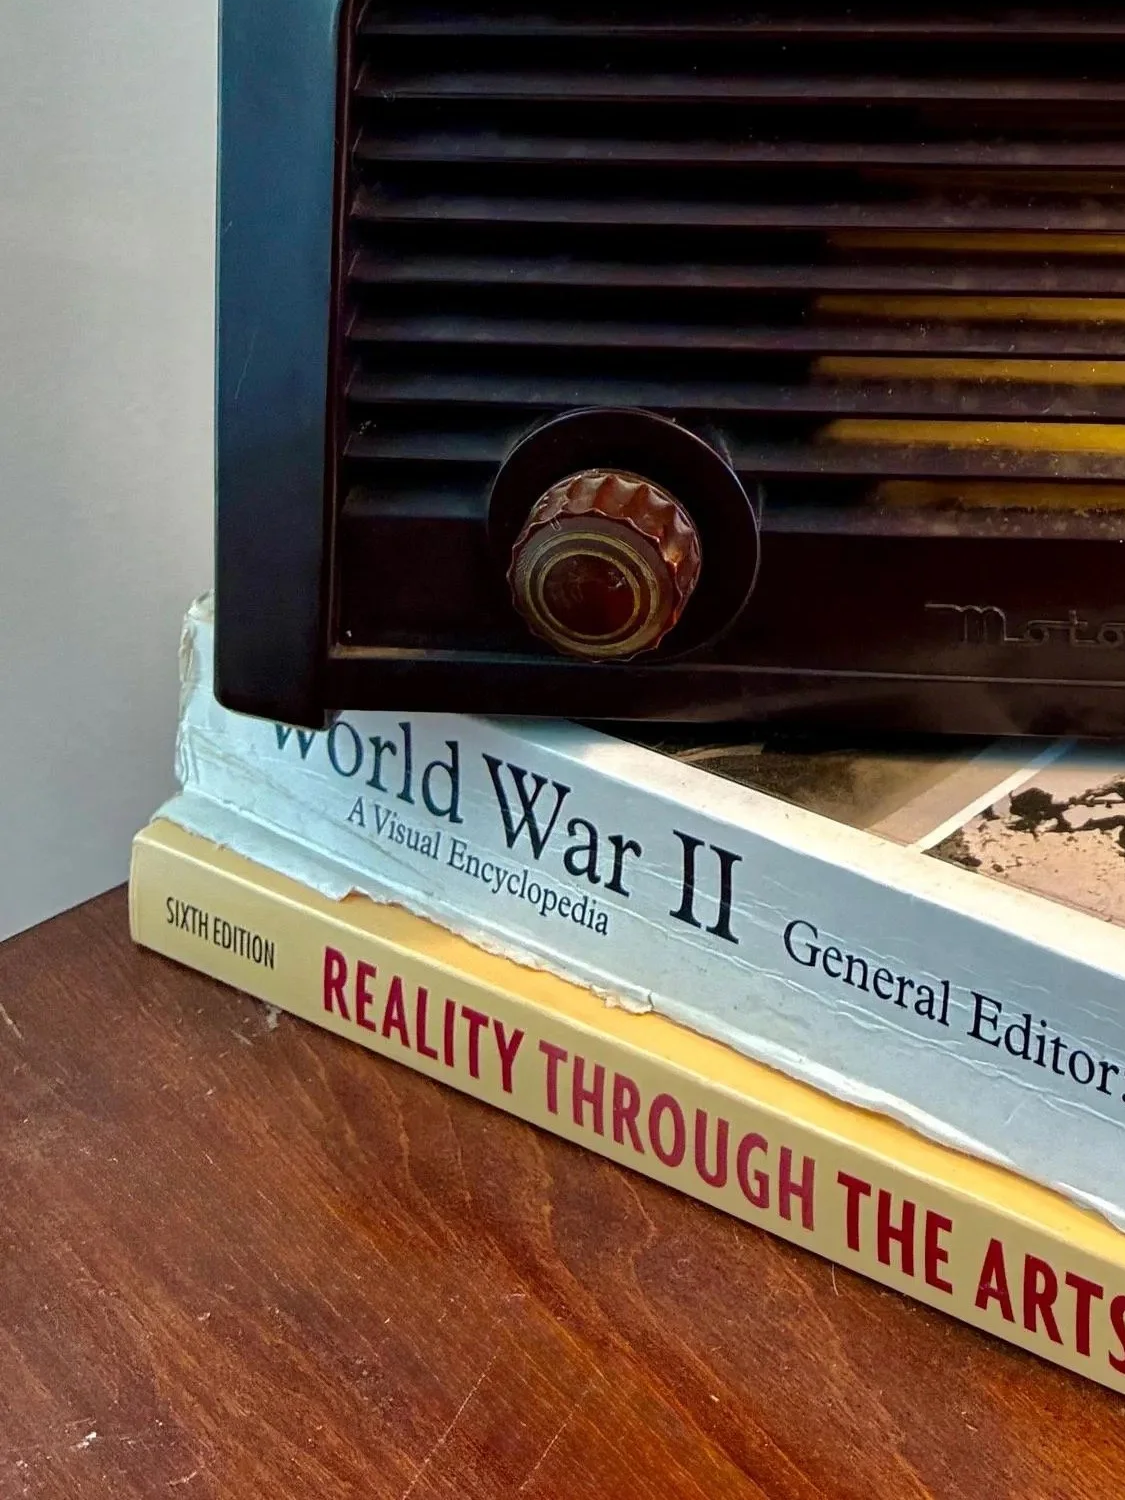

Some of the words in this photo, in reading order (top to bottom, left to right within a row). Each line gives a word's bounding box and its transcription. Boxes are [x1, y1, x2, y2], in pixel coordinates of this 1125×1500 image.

[348, 796, 366, 828] A
[374, 804, 440, 861] Visual
[448, 839, 610, 936] Encyclopedia
[482, 753, 642, 897] War
[669, 829, 743, 944] II
[166, 897, 210, 941] SIXTH
[212, 914, 276, 970] EDITION
[783, 919, 951, 1027] General
[322, 947, 525, 1094] REALITY
[539, 1039, 814, 1232] THROUGH
[837, 1171, 953, 1293] THE
